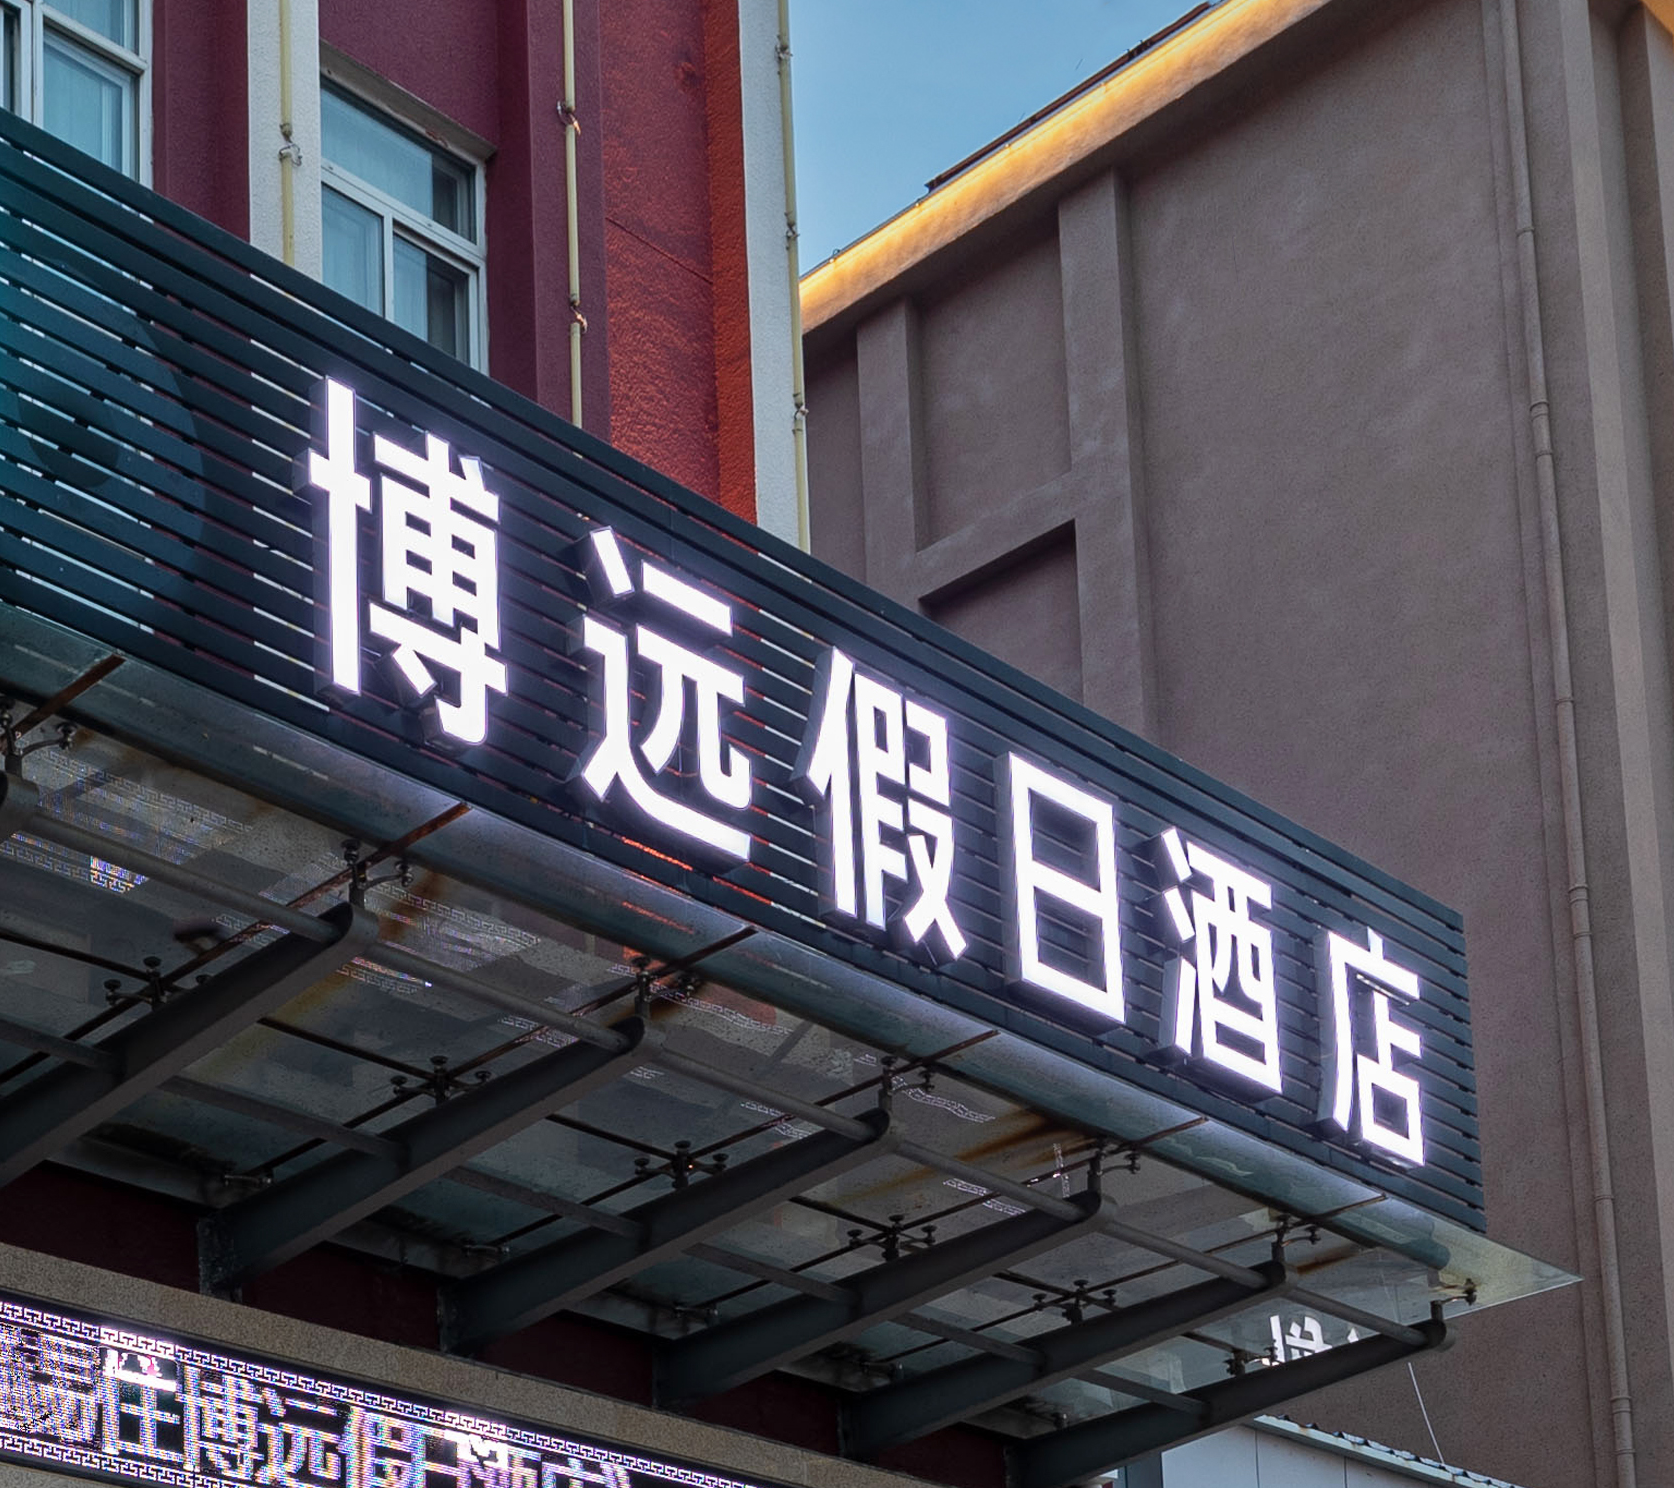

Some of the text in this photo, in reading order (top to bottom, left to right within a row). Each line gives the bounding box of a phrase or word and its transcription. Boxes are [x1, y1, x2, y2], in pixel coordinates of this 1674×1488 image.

[309, 375, 1425, 1169] 博远假日酒店
